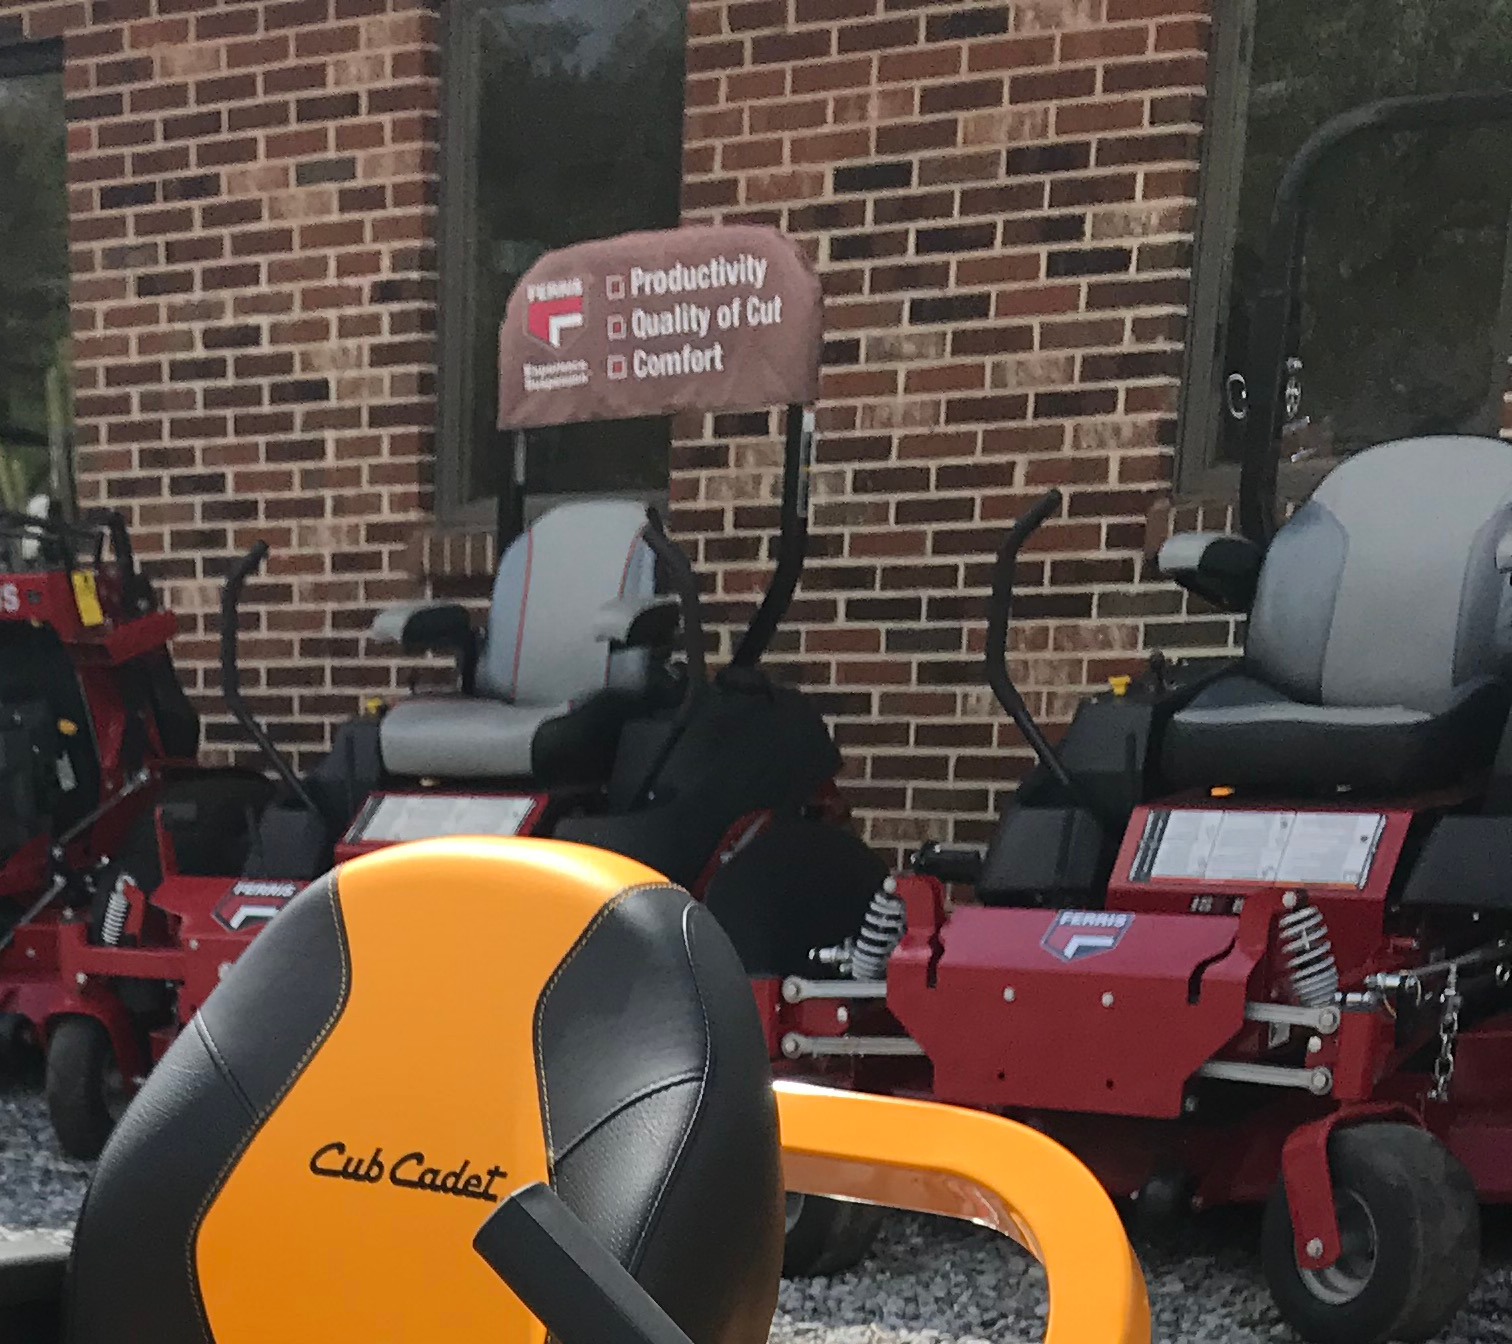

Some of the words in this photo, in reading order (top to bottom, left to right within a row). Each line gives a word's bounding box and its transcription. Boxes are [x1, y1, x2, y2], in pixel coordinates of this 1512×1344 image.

[630, 254, 768, 297] Productivity
[632, 302, 711, 341] Quality
[716, 301, 741, 329] of
[746, 295, 783, 327] Cut
[632, 342, 724, 380] Comfort
[1058, 910, 1129, 928] FERRIS
[309, 1141, 385, 1184] Cub
[389, 1151, 509, 1203] Cadet
